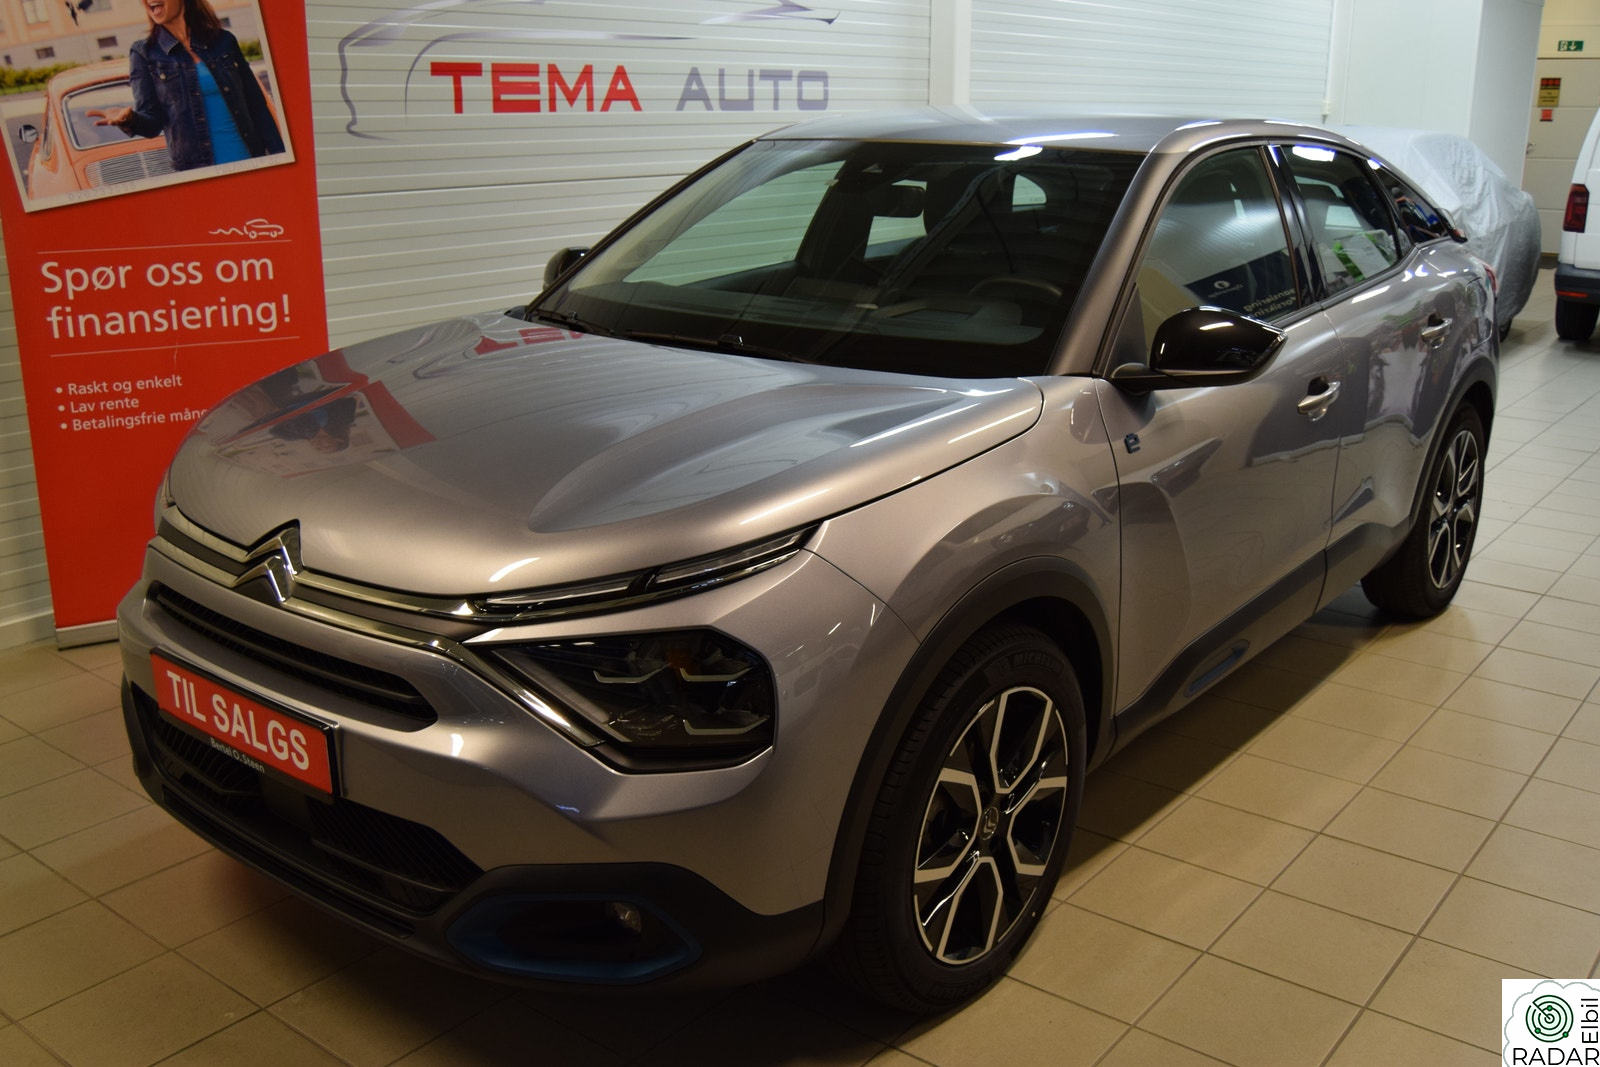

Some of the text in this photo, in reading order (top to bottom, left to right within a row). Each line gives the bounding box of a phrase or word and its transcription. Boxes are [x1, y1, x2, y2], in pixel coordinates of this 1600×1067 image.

[430, 62, 829, 114] TEMA AUTO
[41, 257, 274, 300] Spør oss om
[46, 294, 291, 339] finansiering!
[68, 374, 183, 395] Raskt og enkelt
[70, 397, 139, 413] Lav rente
[72, 411, 165, 431] Betalingsfrie
[166, 670, 310, 771] TIL SALGS
[210, 736, 232, 757] Bertel
